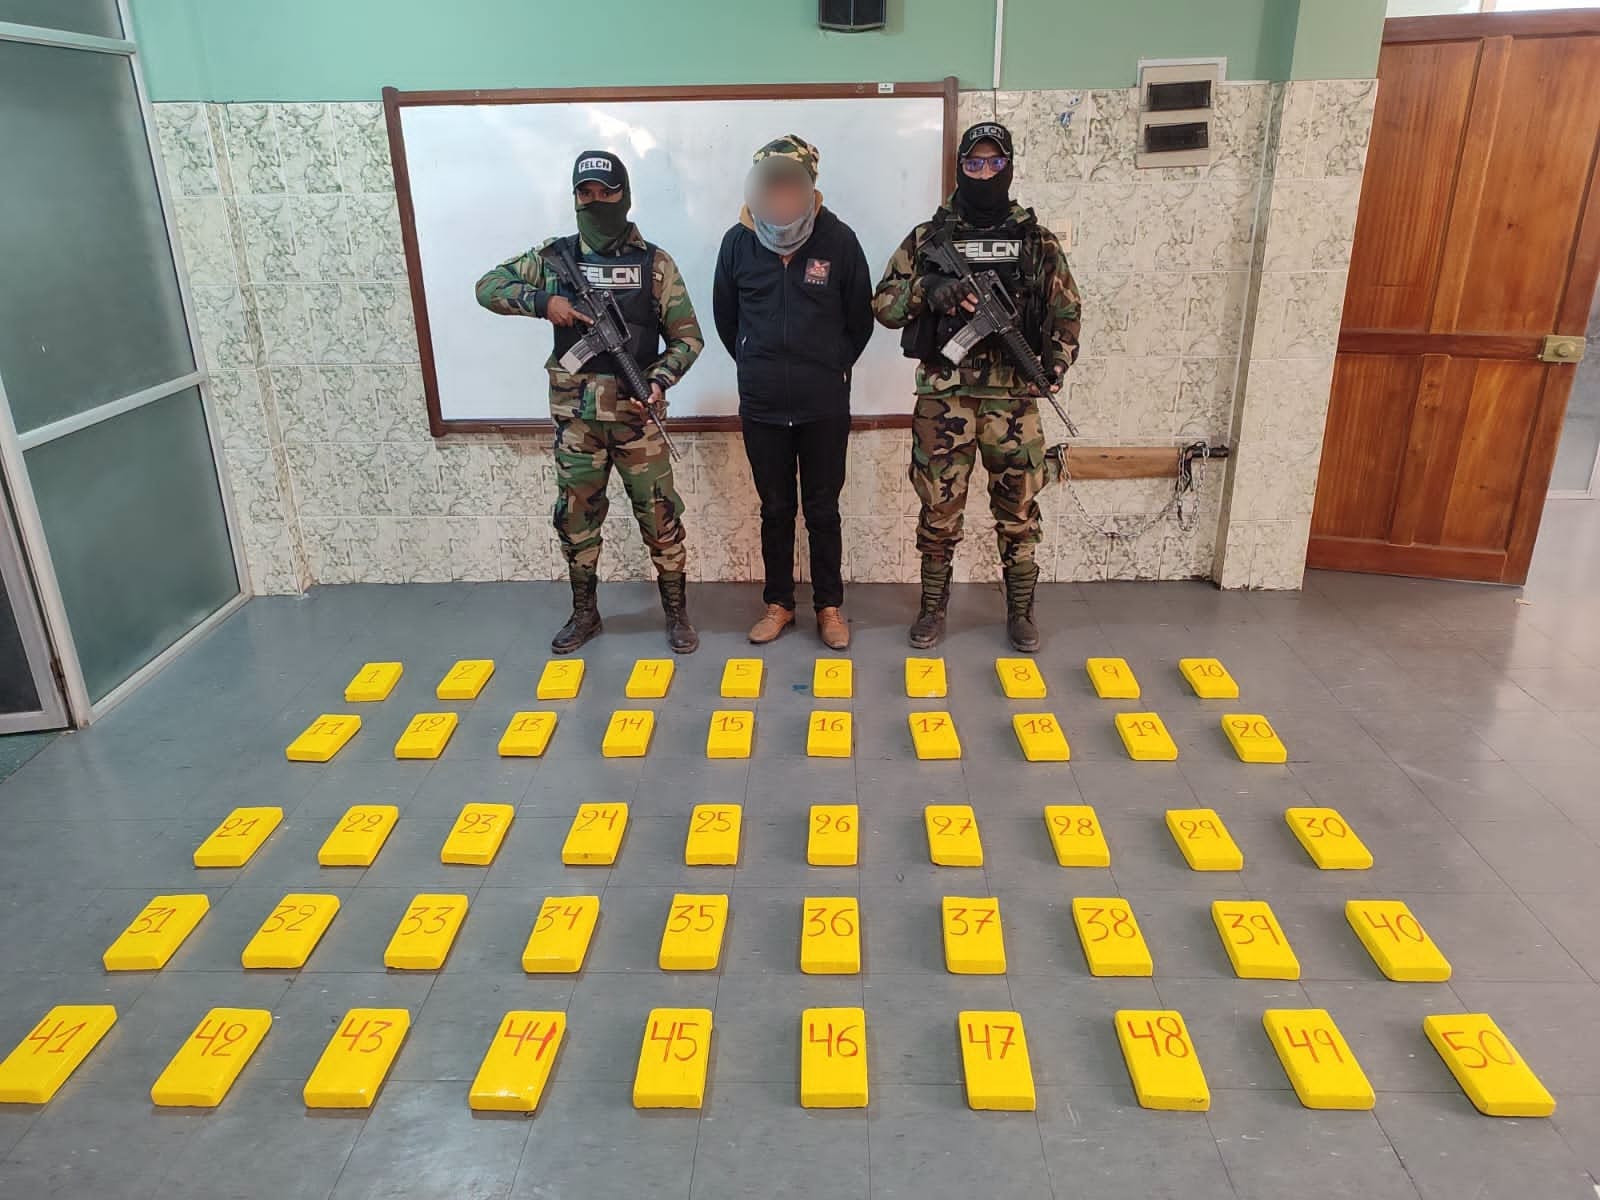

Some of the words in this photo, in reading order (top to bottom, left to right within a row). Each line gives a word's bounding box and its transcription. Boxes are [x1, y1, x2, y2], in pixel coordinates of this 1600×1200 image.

[970, 125, 1004, 139] FELCN
[580, 159, 609, 169] FELCN
[361, 669, 381, 684] 1
[452, 664, 477, 681] 2
[551, 664, 569, 679] 3
[643, 663, 659, 680] 4
[735, 663, 752, 679] 5
[824, 665, 841, 679] 6
[919, 664, 934, 679] 7
[1012, 665, 1032, 682] 8
[1101, 664, 1120, 680] 9
[1191, 663, 1225, 678] 10
[307, 721, 345, 736] 11
[409, 716, 446, 733] 12
[512, 717, 545, 733] 13
[613, 716, 645, 733] 14
[714, 715, 745, 732] 15
[815, 717, 845, 733] 16
[915, 717, 948, 734] 17
[1022, 717, 1055, 735] 18
[1127, 720, 1161, 737] 19
[1231, 719, 1275, 739] 20
[215, 817, 260, 838] 21
[341, 813, 384, 833] 22
[457, 812, 499, 835] 23
[575, 809, 619, 832] 24
[694, 810, 732, 833] 25
[815, 814, 851, 835] 26
[932, 816, 973, 836] 27
[1053, 815, 1096, 837] 28
[1179, 819, 1221, 840] 29
[1300, 816, 1348, 839] 30
[127, 906, 177, 935] 31
[261, 904, 317, 934] 32
[401, 906, 455, 936] 33
[535, 905, 584, 933] 34
[668, 903, 717, 933] 35
[806, 907, 855, 938] 36
[946, 907, 996, 937] 37
[1079, 907, 1137, 943] 38
[1362, 911, 1425, 943] 40
[1223, 912, 1281, 946] 39
[27, 1017, 88, 1055] 41
[194, 1018, 249, 1057] 42
[339, 1017, 393, 1054] 43
[503, 1018, 558, 1062] 44
[649, 1019, 700, 1064] 45
[808, 1022, 859, 1058] 46
[967, 1023, 1016, 1061] 47
[1126, 1015, 1190, 1059] 48
[1283, 1025, 1345, 1064] 49
[1441, 1029, 1516, 1070] 50
